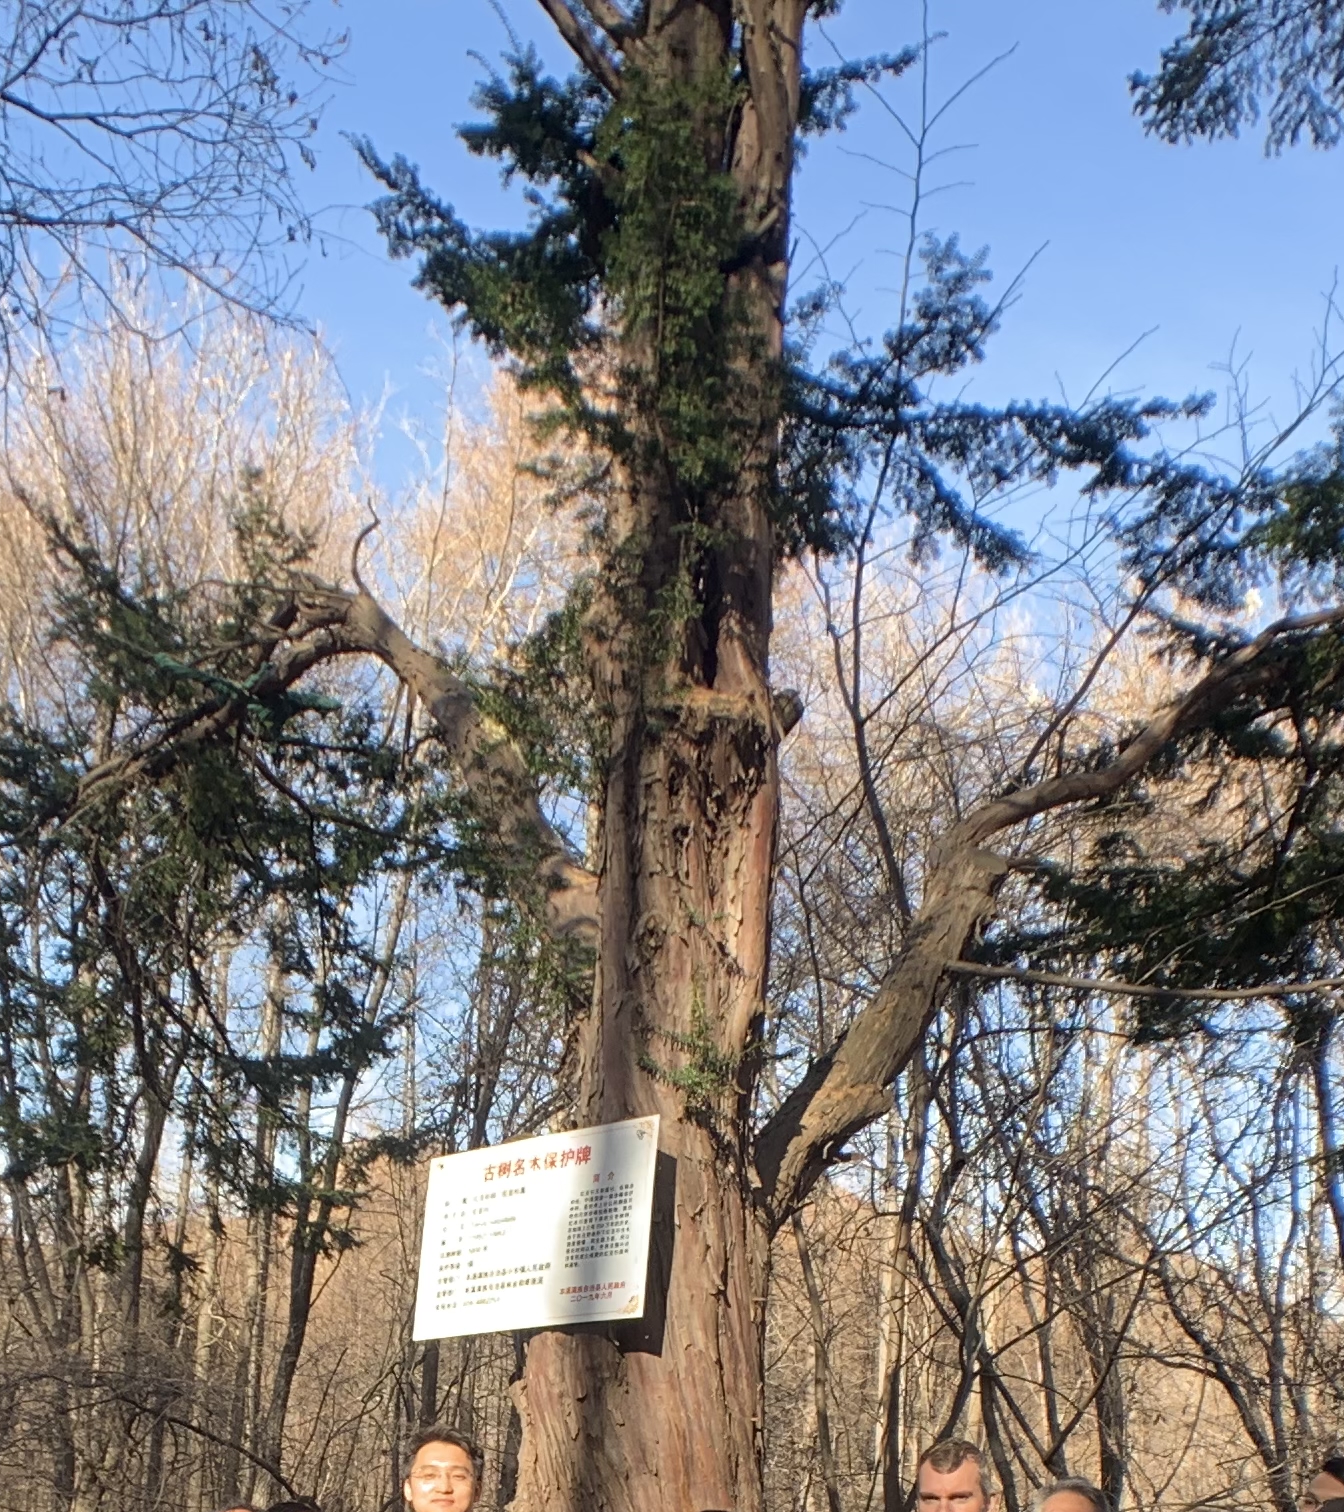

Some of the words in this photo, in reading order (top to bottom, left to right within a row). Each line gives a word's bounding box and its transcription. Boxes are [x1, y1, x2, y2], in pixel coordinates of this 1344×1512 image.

[484, 1145, 592, 1182] 古树名木保护牌
